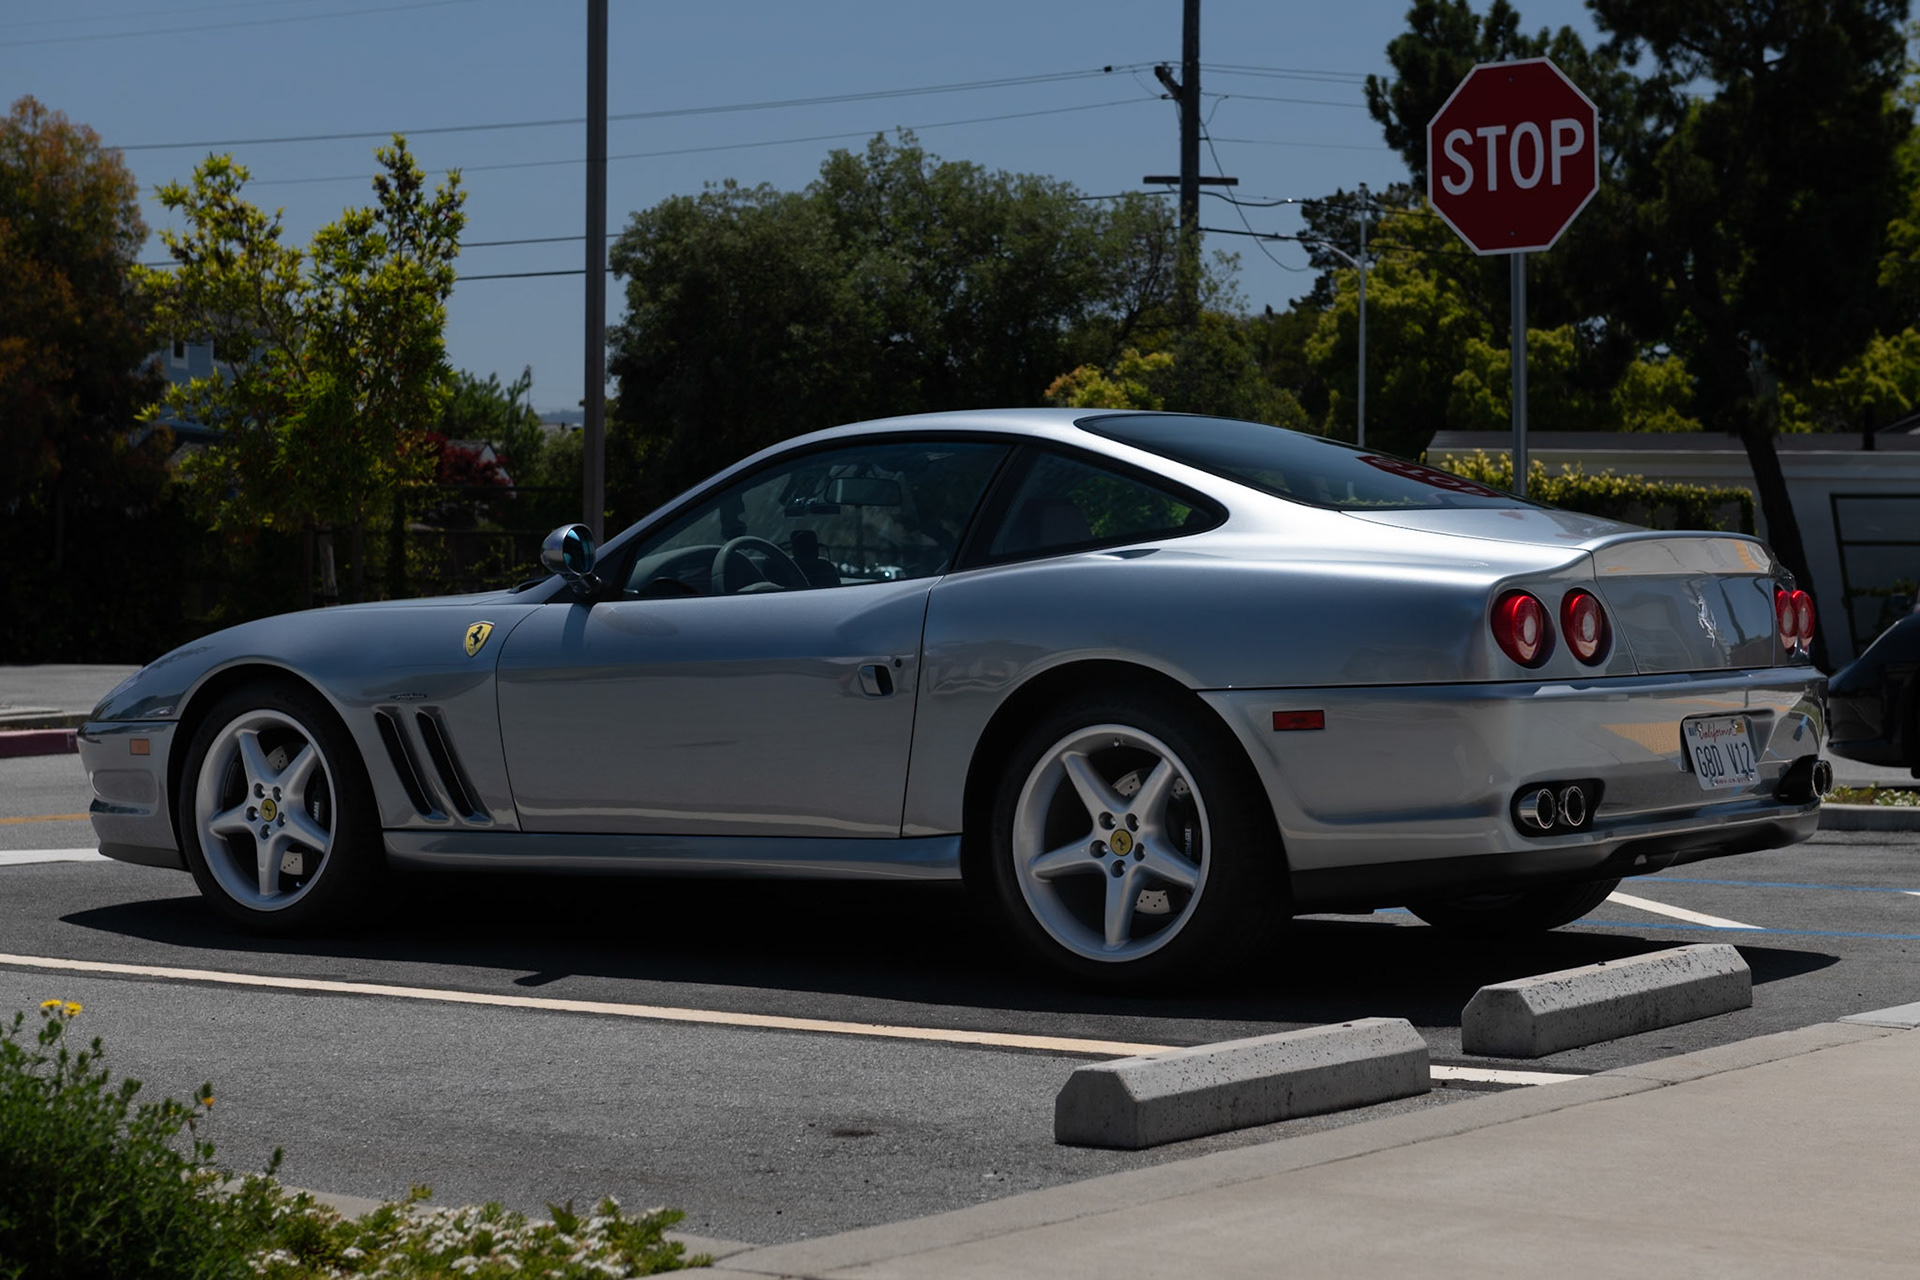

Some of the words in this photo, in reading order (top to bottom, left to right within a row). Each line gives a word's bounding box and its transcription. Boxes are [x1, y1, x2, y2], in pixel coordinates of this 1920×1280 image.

[1441, 118, 1585, 195] STOP
[1699, 723, 1736, 743] California
[1696, 745, 1724, 778] G8D
[1725, 743, 1755, 774] V12
